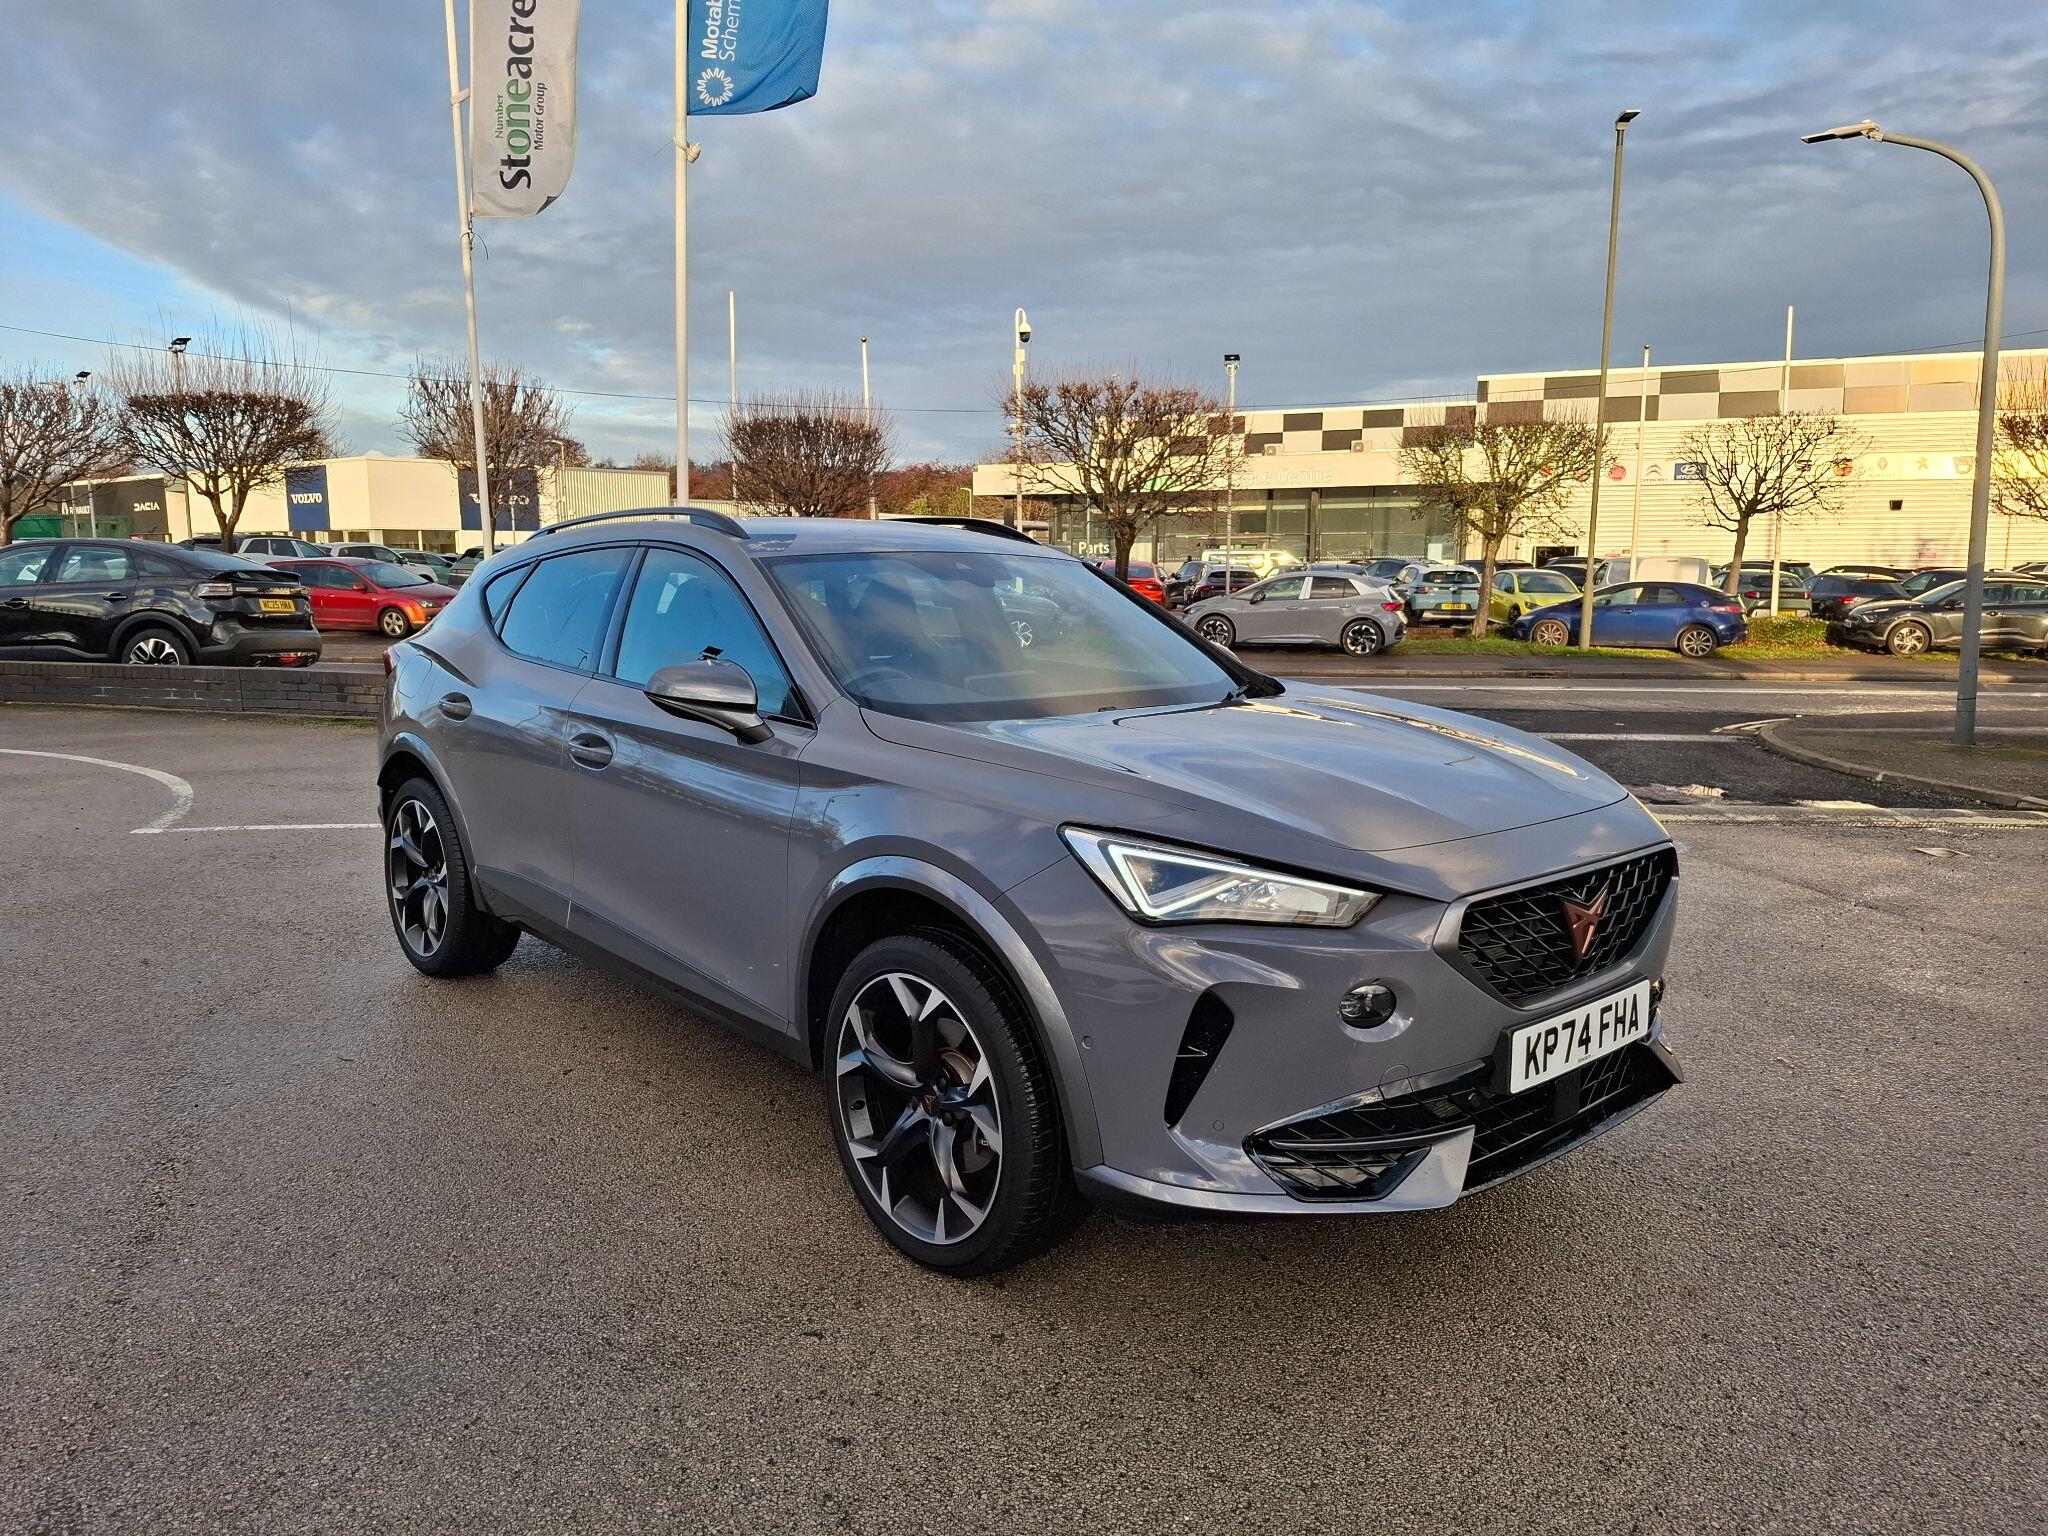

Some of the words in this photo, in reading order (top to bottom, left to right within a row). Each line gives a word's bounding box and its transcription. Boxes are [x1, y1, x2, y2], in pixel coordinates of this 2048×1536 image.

[718, 0, 741, 62] Schem
[500, 0, 536, 190] Stoneacre
[534, 82, 548, 116] Group
[495, 94, 504, 139] Number
[534, 118, 544, 151] Motor
[1276, 467, 1334, 485] Centre
[133, 501, 160, 512] DACIA
[290, 492, 323, 504] VOLVO
[1078, 541, 1110, 554] Parts
[1524, 1012, 1592, 1080] KP74
[1598, 993, 1640, 1049] FHA
